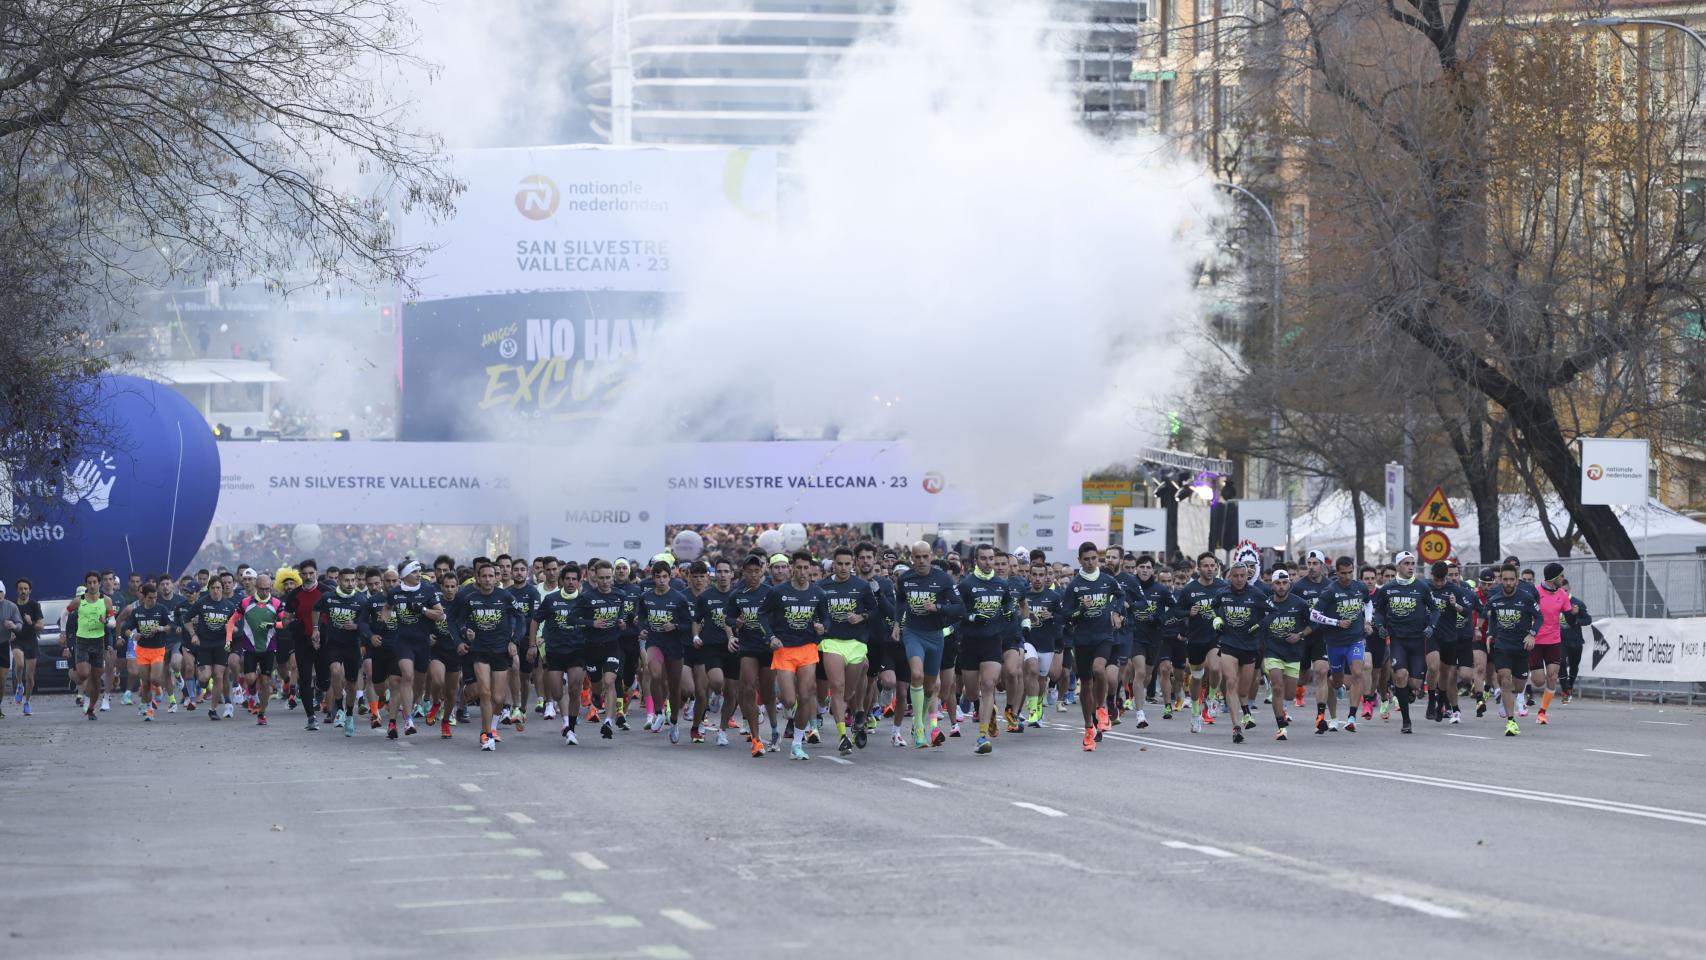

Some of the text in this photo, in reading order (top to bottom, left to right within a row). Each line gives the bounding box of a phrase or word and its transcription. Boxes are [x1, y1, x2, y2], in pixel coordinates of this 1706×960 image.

[569, 180, 642, 194] nationale
[569, 197, 669, 211] nederlanden
[517, 240, 669, 255] SAN SILVESTRE
[517, 257, 670, 271] VALLECANA 23
[526, 319, 656, 361] NO HAY
[478, 354, 633, 411] EXCUS
[269, 476, 511, 489] SAN SILVESTRE VALLECANA 23
[668, 476, 908, 489] SAN SILVESTRE VALLECANA 23
[565, 510, 631, 524] MADRID
[0, 523, 65, 545] espeto
[1424, 541, 1444, 553] 30
[1618, 634, 1644, 662] Polestar
[1648, 635, 1676, 664] Polestar
